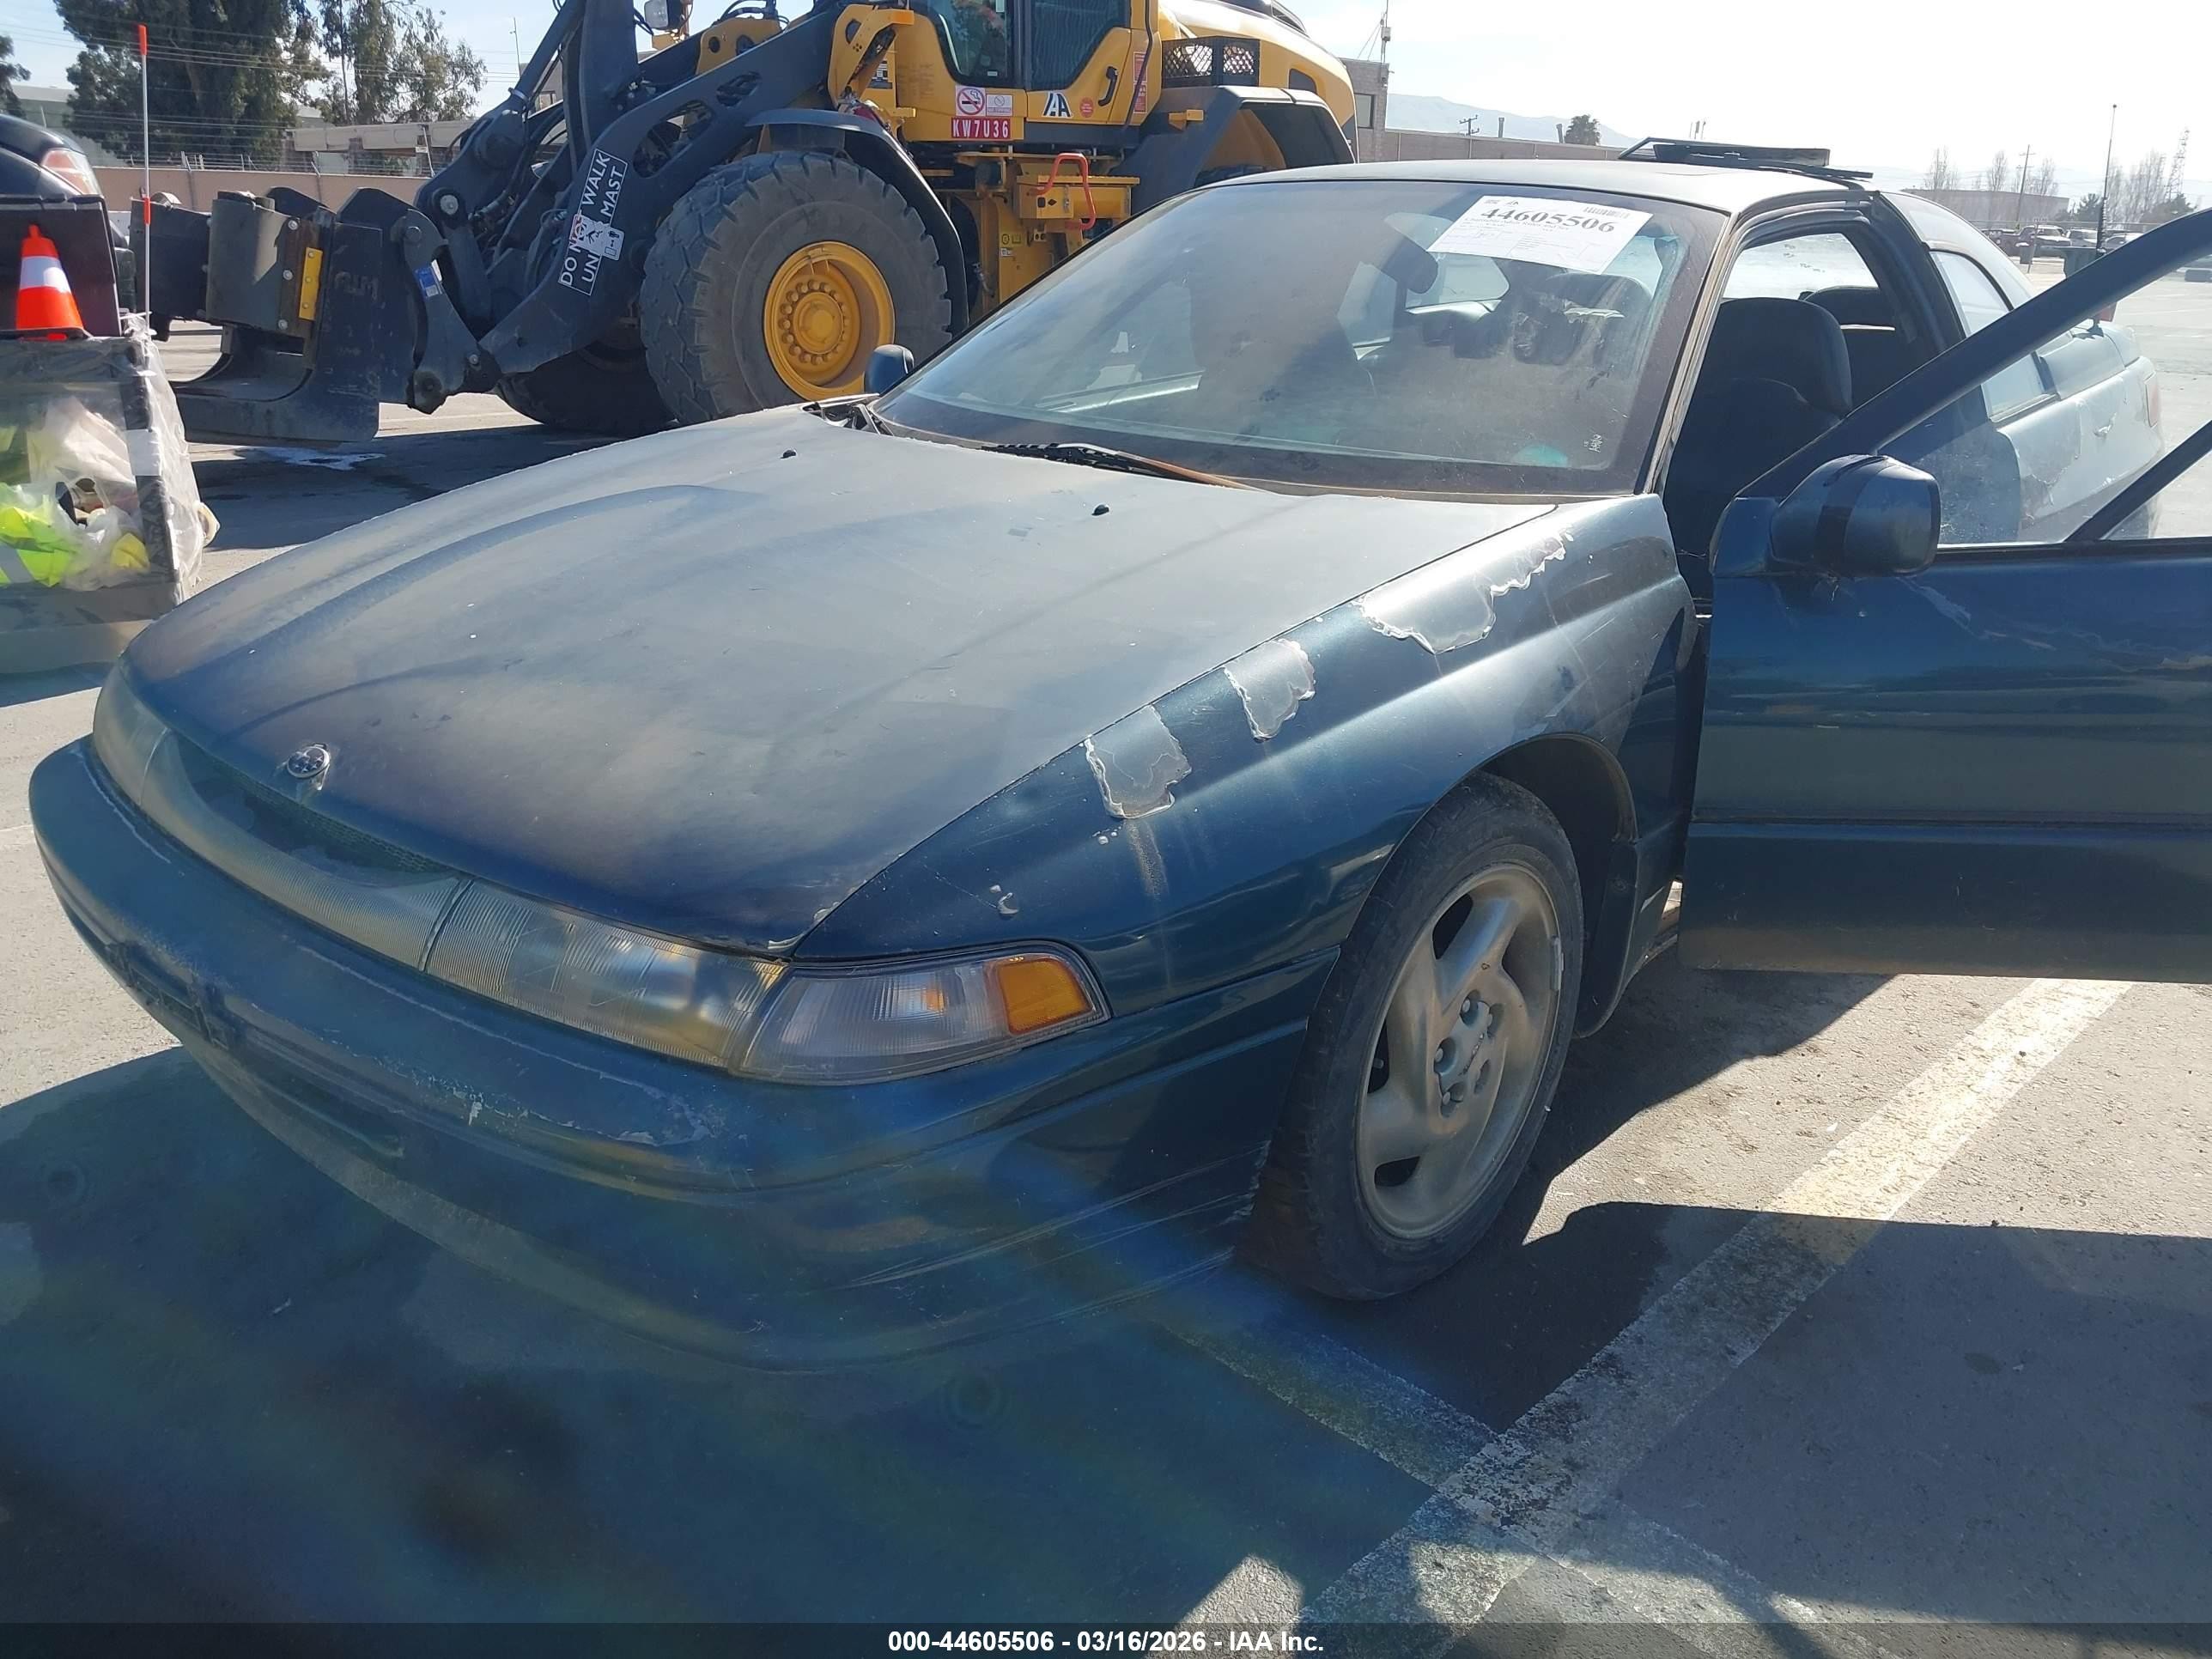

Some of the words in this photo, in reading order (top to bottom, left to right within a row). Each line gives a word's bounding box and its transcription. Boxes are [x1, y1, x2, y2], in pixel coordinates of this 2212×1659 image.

[952, 118, 1009, 138] KW7U36
[600, 166, 624, 217] MAST
[560, 257, 578, 286] DO
[582, 152, 611, 205] WALK
[1481, 207, 1615, 233] 44605506
